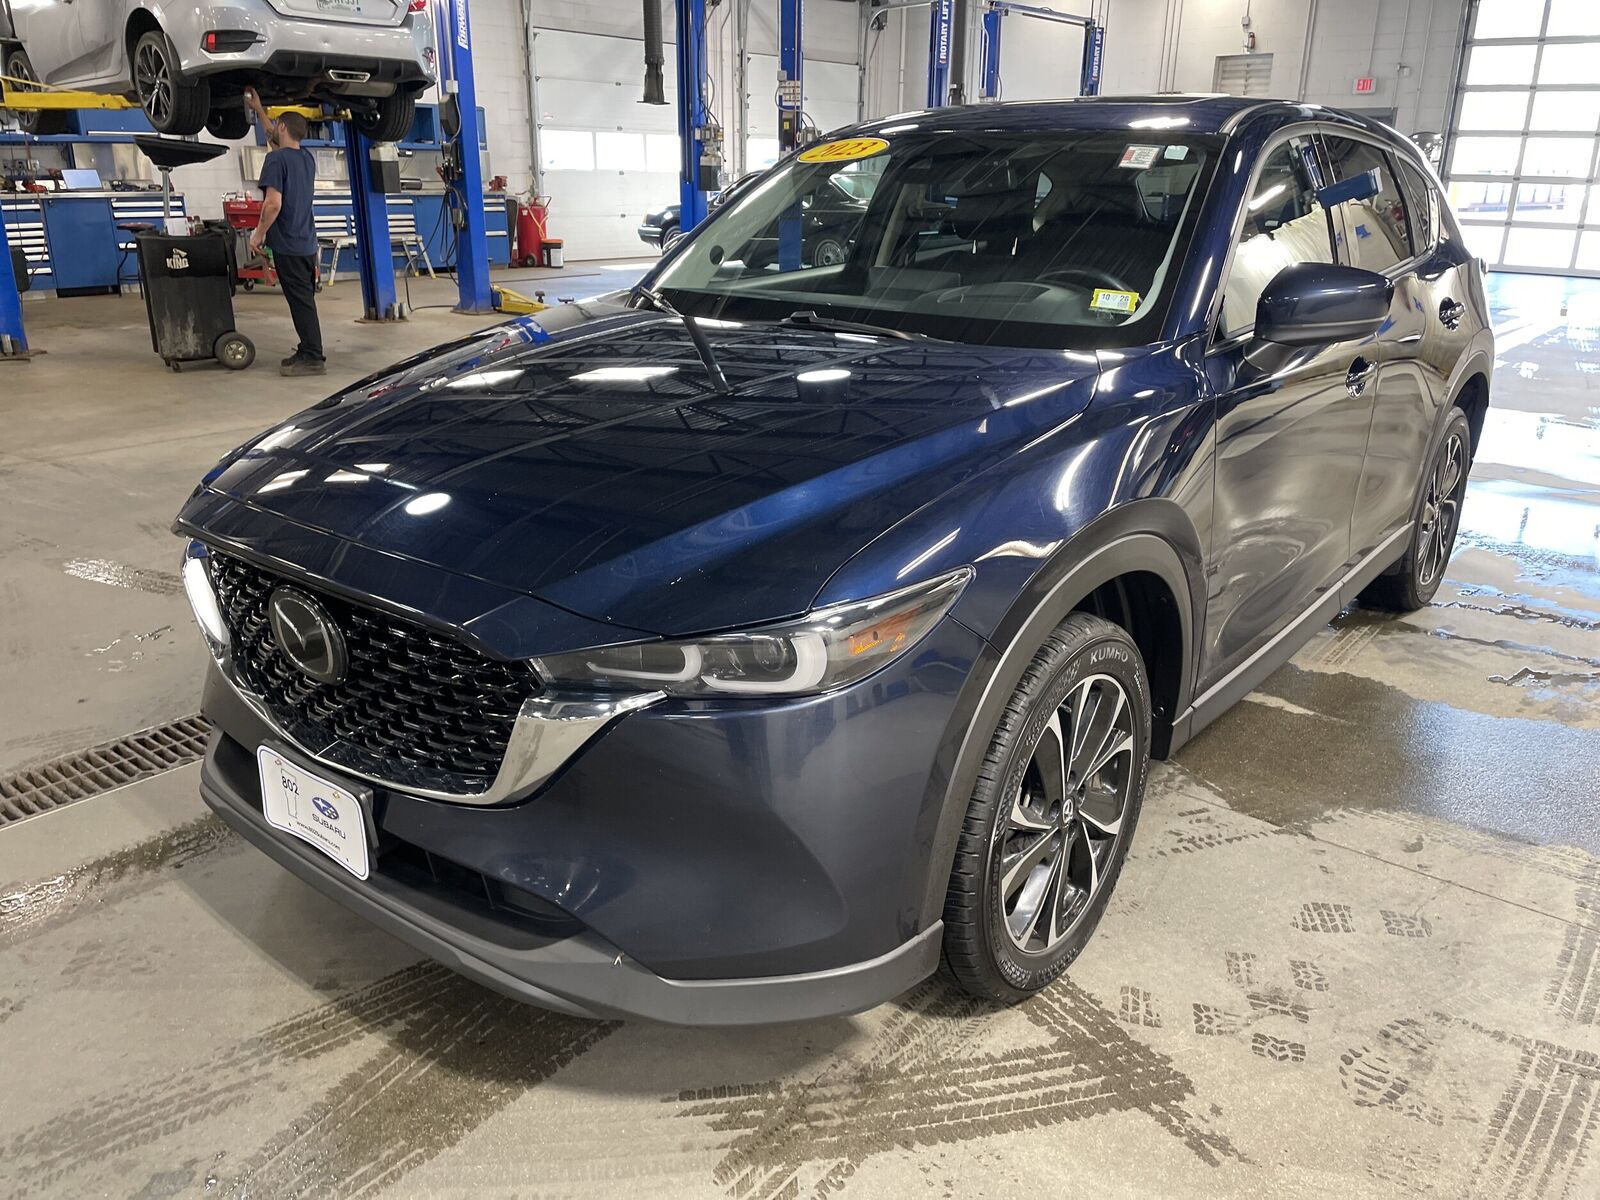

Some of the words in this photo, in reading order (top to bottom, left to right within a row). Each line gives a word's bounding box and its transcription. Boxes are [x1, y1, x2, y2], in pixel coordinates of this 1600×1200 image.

[942, 0, 950, 20] LIFT
[457, 0, 469, 50] FORWAR
[940, 21, 948, 59] ROTARY
[1092, 45, 1100, 77] ROTARY
[1356, 79, 1372, 90] EXIT
[805, 142, 878, 159] 2023
[1090, 647, 1129, 665] KUMHO
[281, 775, 300, 796] 802
[312, 813, 346, 839] SUBARU
